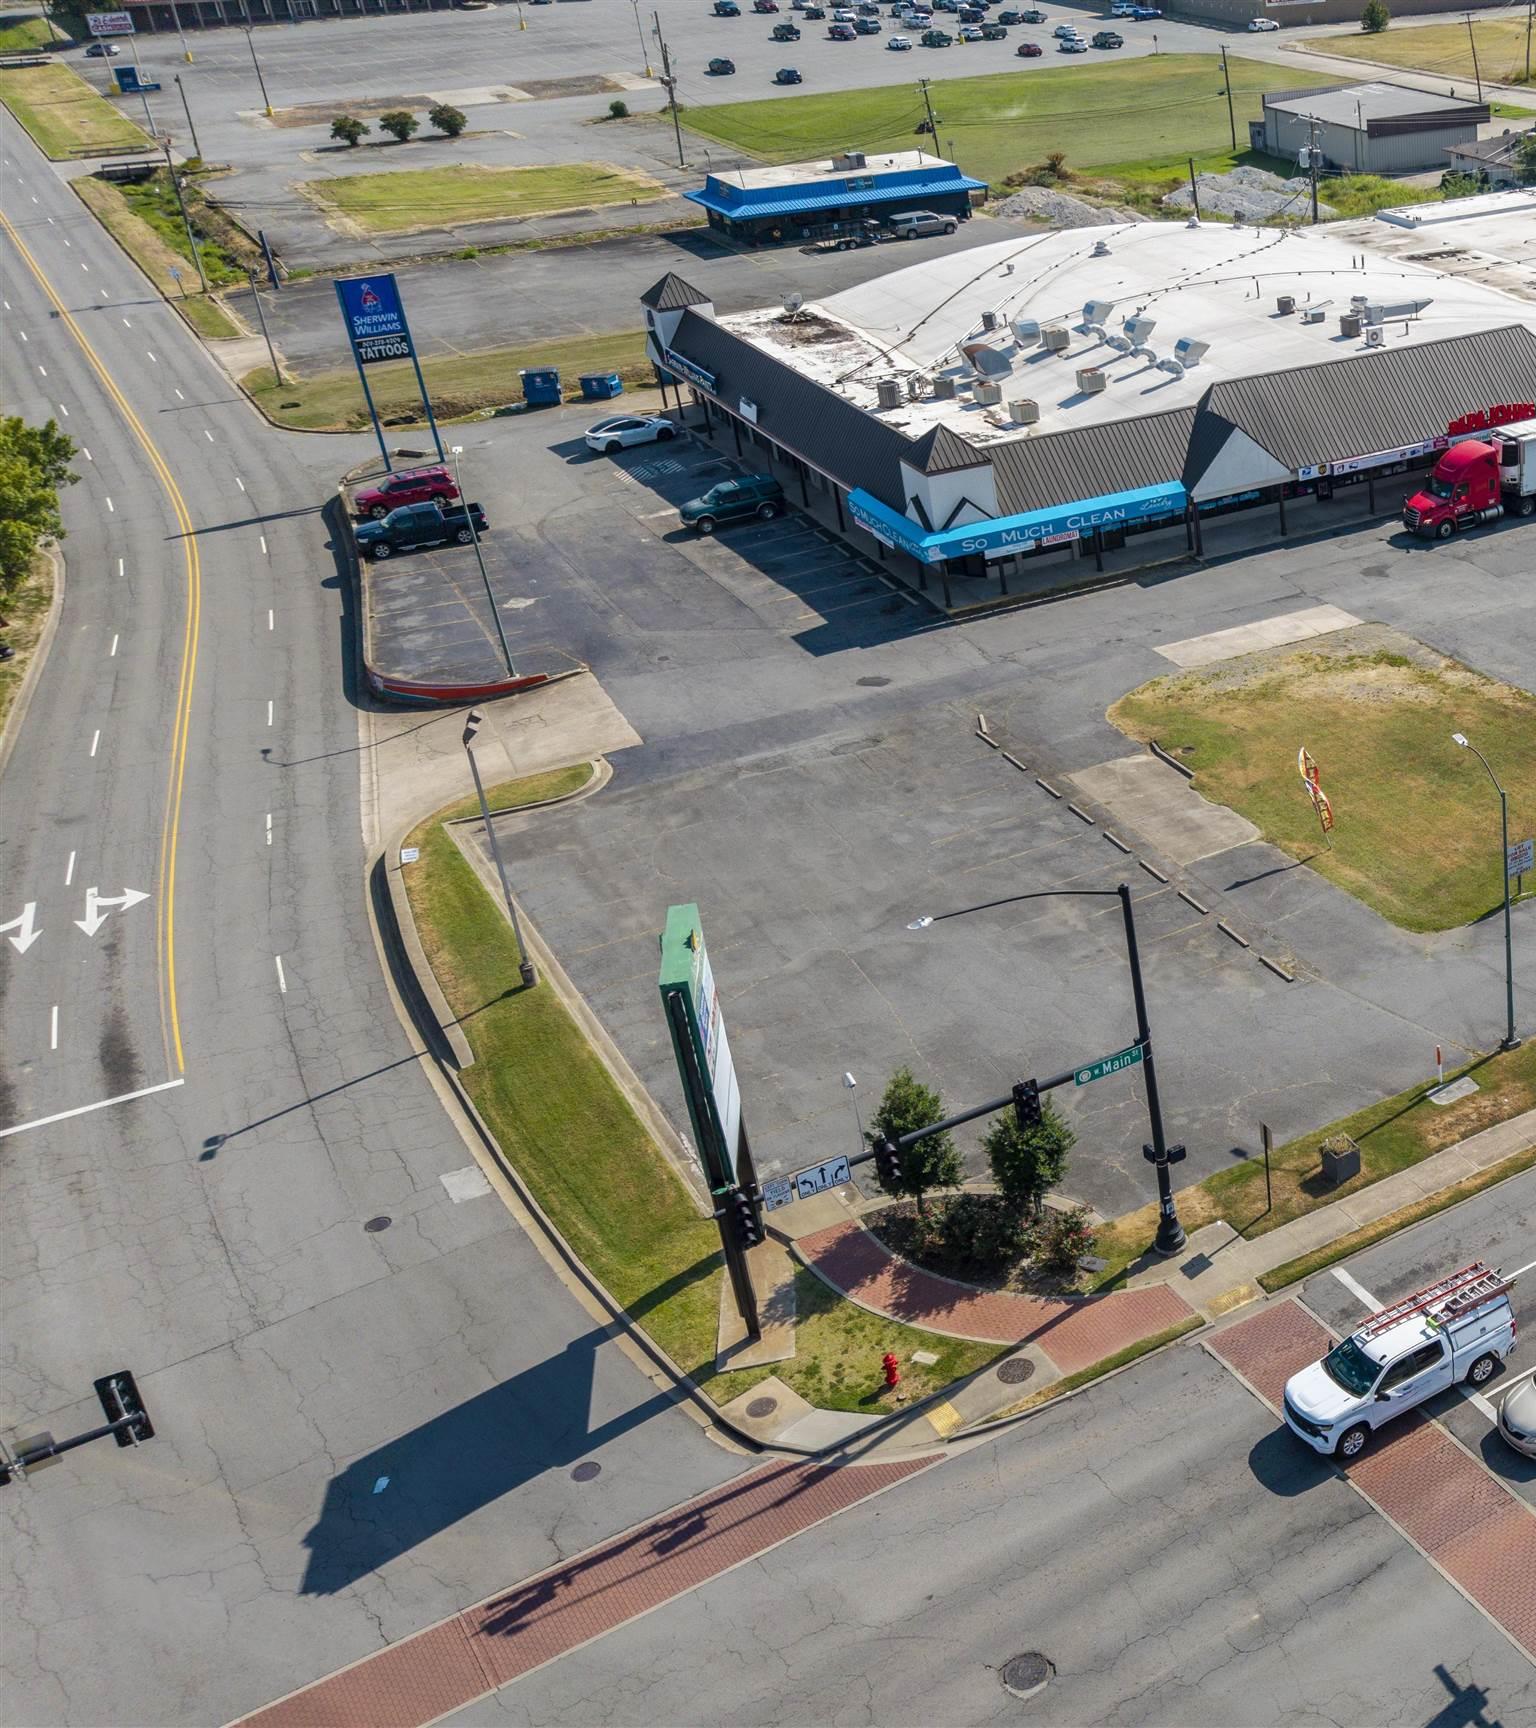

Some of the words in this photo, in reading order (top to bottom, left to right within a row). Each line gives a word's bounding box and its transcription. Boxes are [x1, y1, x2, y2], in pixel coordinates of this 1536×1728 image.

[353, 312, 398, 326] SHERWIN
[354, 321, 401, 336] WILLIAMS
[359, 342, 409, 360] TATTOOS
[1448, 408, 1486, 436] PAPA
[1001, 523, 1054, 543] MUCH
[1066, 508, 1126, 530] CLEAN
[1102, 1055, 1131, 1075] Main
